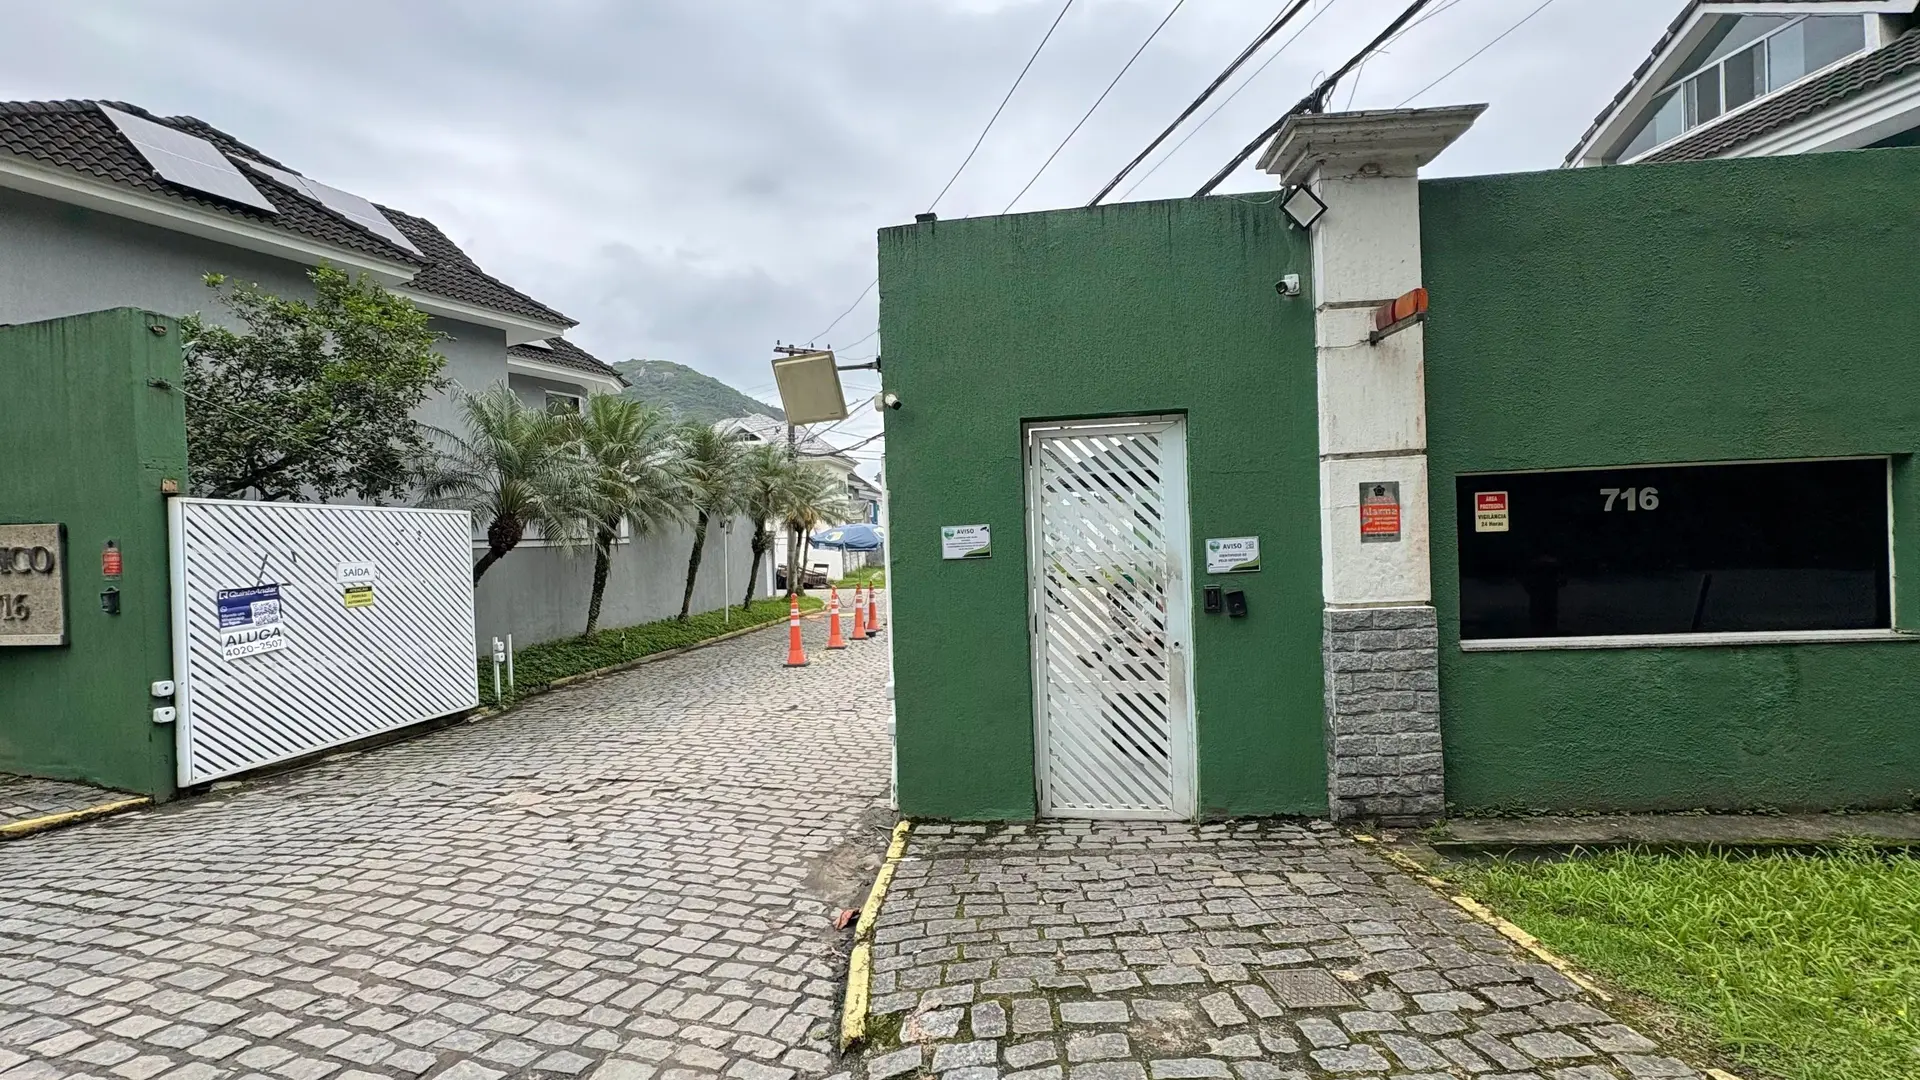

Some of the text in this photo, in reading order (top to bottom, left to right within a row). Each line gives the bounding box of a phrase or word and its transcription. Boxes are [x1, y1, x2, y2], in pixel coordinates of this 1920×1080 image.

[1600, 487, 1659, 511] 716
[1222, 542, 1242, 550] AVISO
[343, 566, 370, 577] SAÍDA
[228, 586, 277, 598] QuintoAndar
[0, 594, 31, 621] 16
[225, 627, 281, 647] ALUGA
[226, 639, 282, 656] 4020-2507
